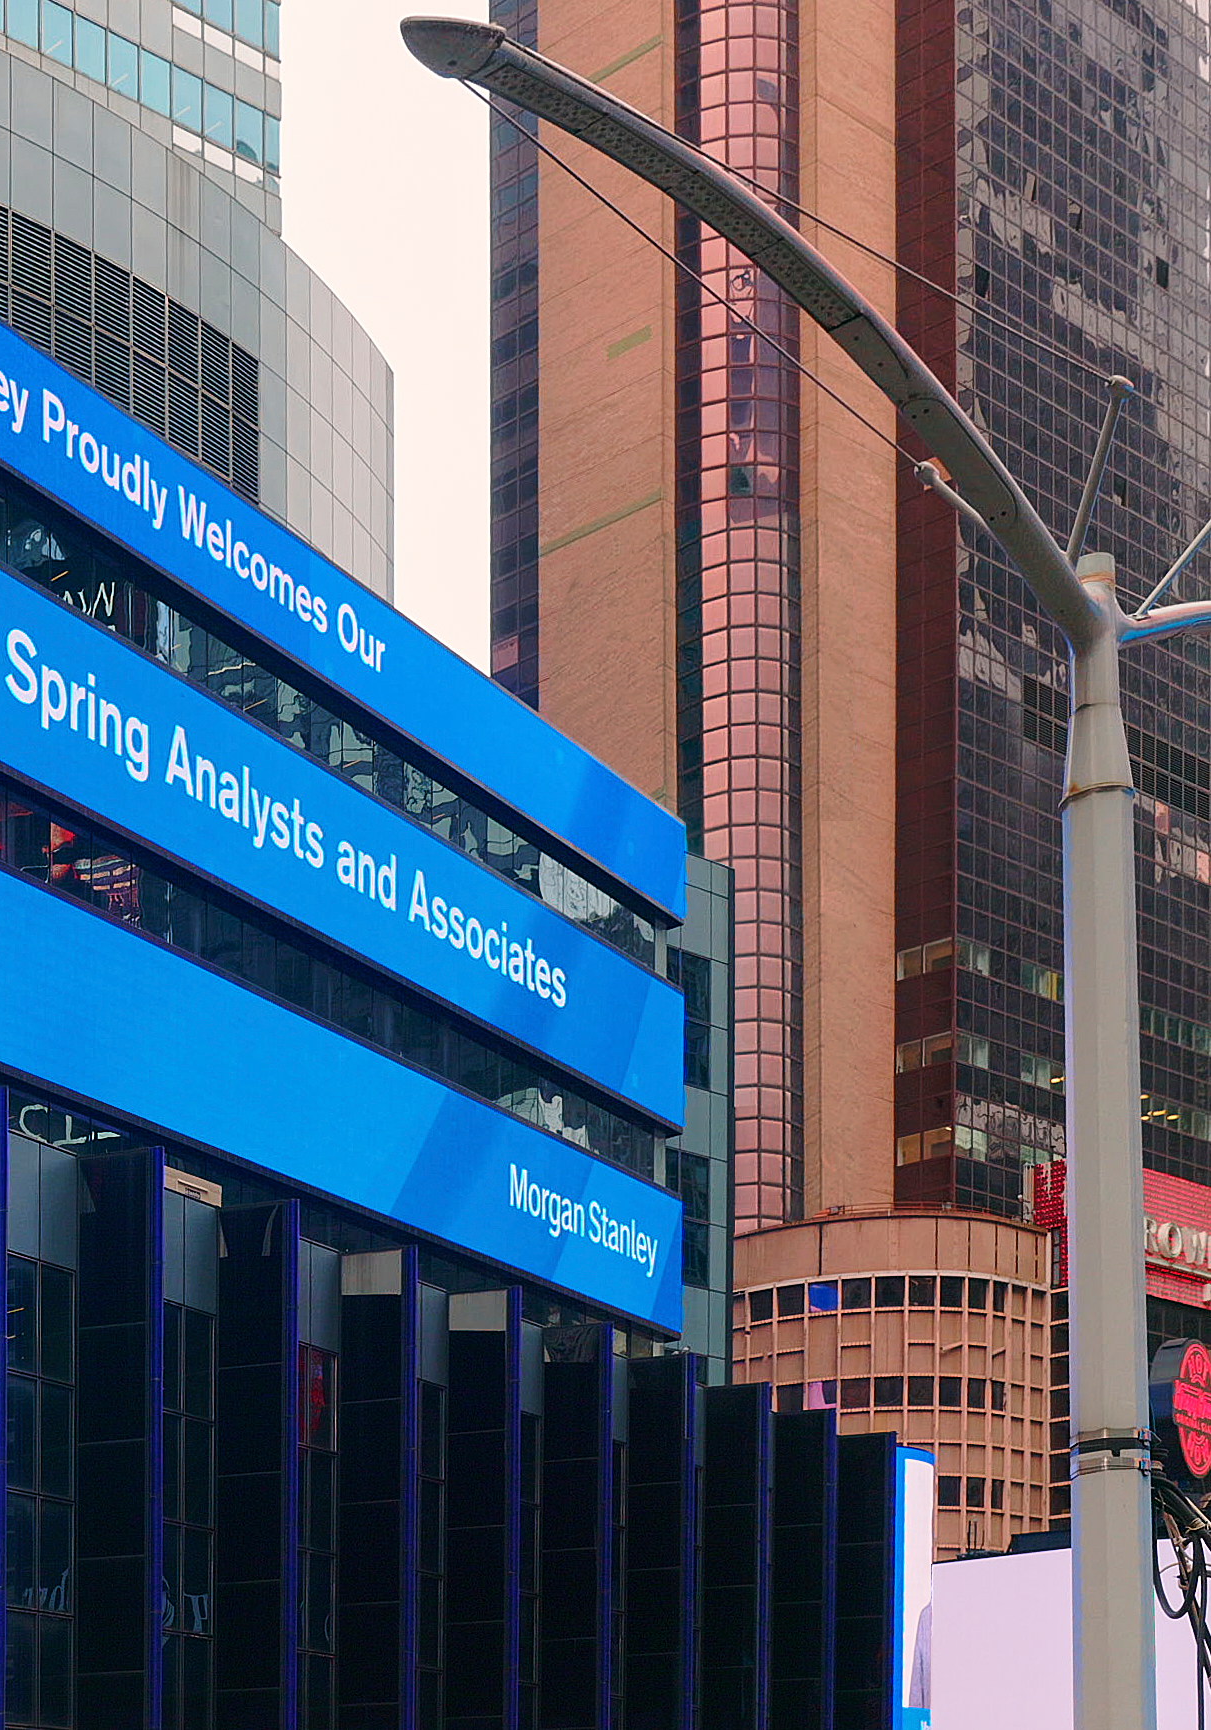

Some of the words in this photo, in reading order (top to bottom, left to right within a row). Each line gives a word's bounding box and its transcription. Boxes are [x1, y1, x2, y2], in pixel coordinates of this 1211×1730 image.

[42, 389, 168, 530] Proudly
[178, 485, 328, 633] Welcomes
[338, 603, 386, 672] Our
[5, 629, 149, 782] Spring
[165, 726, 324, 868] Analysts
[338, 841, 397, 911] and
[409, 870, 566, 1007] Associates
[509, 1163, 585, 1237] Morgan
[589, 1201, 658, 1278] Stanley
